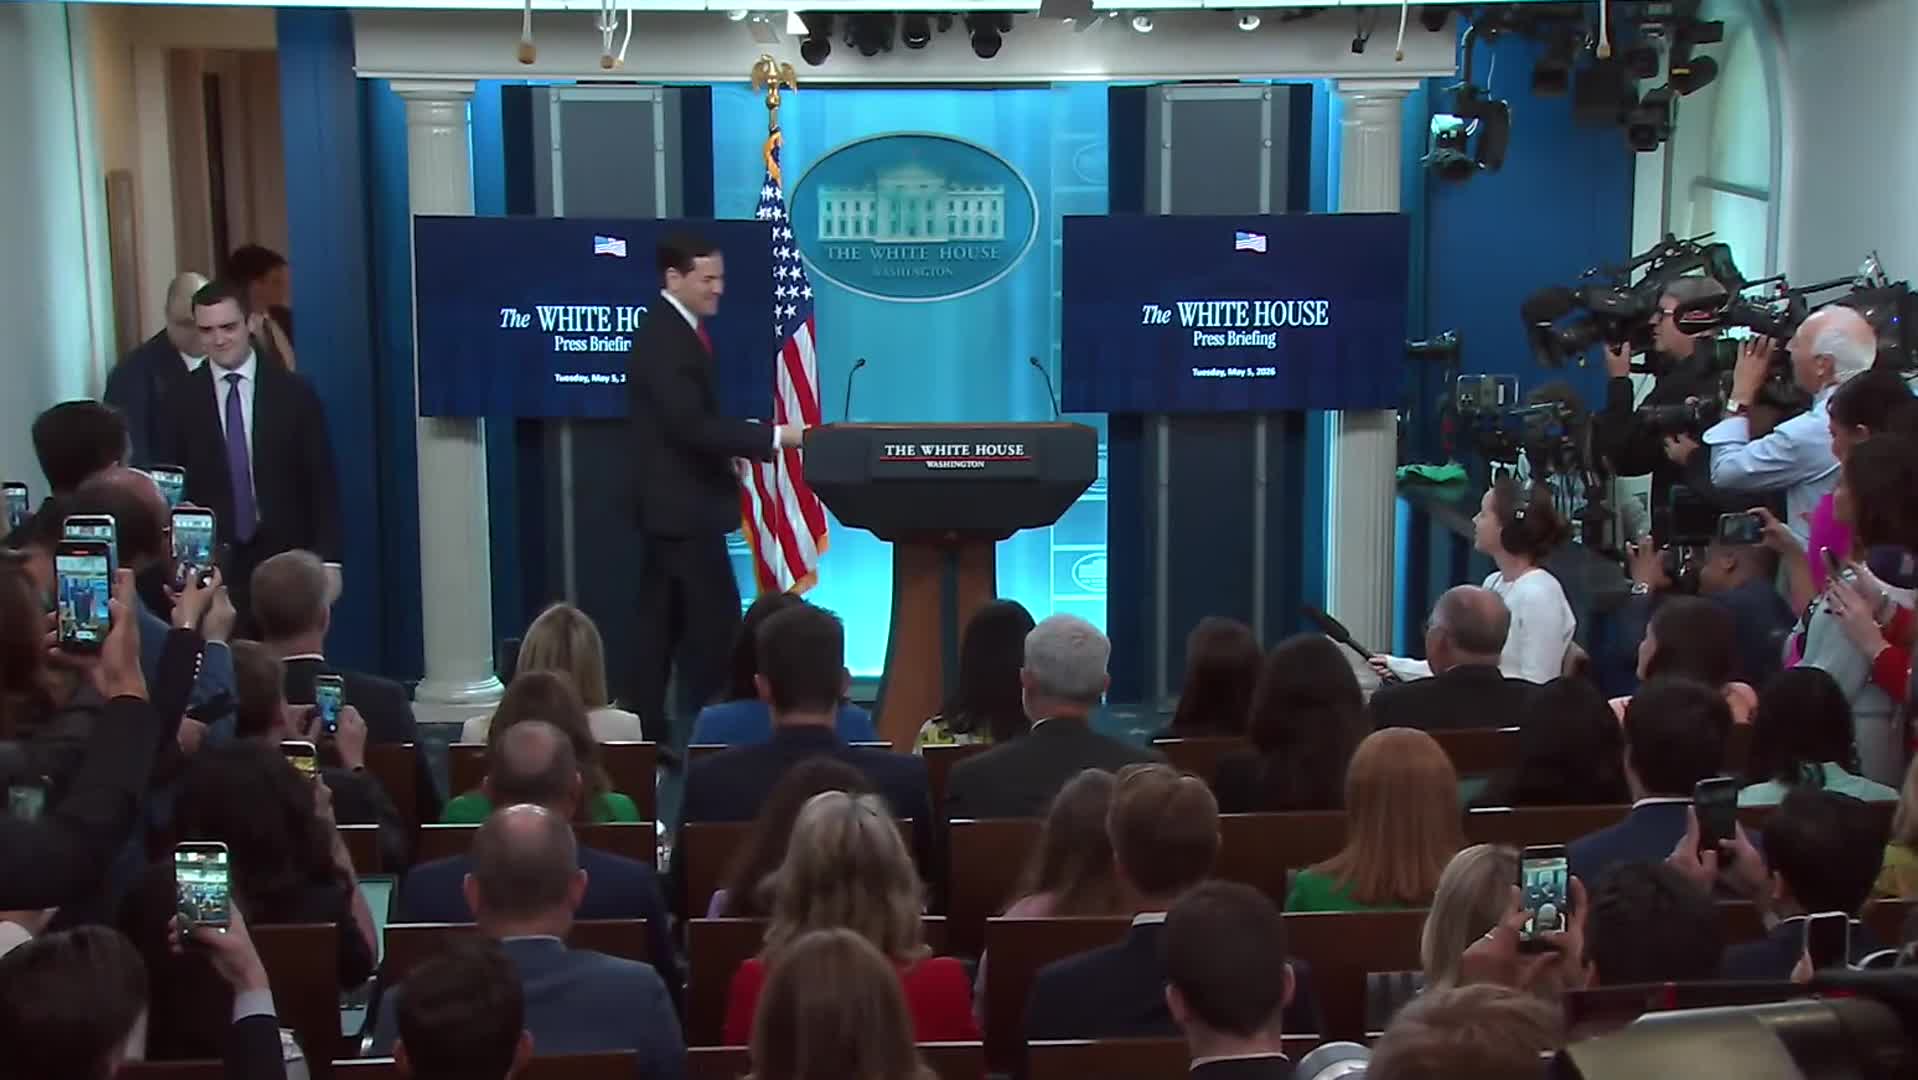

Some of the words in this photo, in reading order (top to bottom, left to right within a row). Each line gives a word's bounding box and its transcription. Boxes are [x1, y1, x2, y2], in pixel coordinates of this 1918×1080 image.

[828, 247, 861, 260] THE
[871, 247, 929, 260] WHITE
[939, 247, 1000, 260] HOUSE
[500, 308, 530, 328] The
[536, 305, 611, 332] WHITE
[1142, 304, 1172, 325] The
[1176, 301, 1249, 327] WHITE
[1253, 300, 1329, 326] HOUSE
[554, 335, 588, 352] Press
[589, 335, 632, 352] Briefin
[1193, 330, 1225, 347] Press
[1227, 330, 1277, 349] Briefing
[554, 373, 590, 384] Tuesday,
[591, 373, 610, 384] May
[611, 373, 619, 384] 5,
[1192, 367, 1226, 378] Tuesday,
[1227, 367, 1246, 378] May
[1247, 367, 1255, 378] 5,
[1256, 367, 1276, 377] 2026
[885, 445, 916, 456] THE
[920, 445, 970, 456] WHITE
[975, 444, 1024, 456] HOUSE
[926, 461, 985, 469] WASHINGTON
